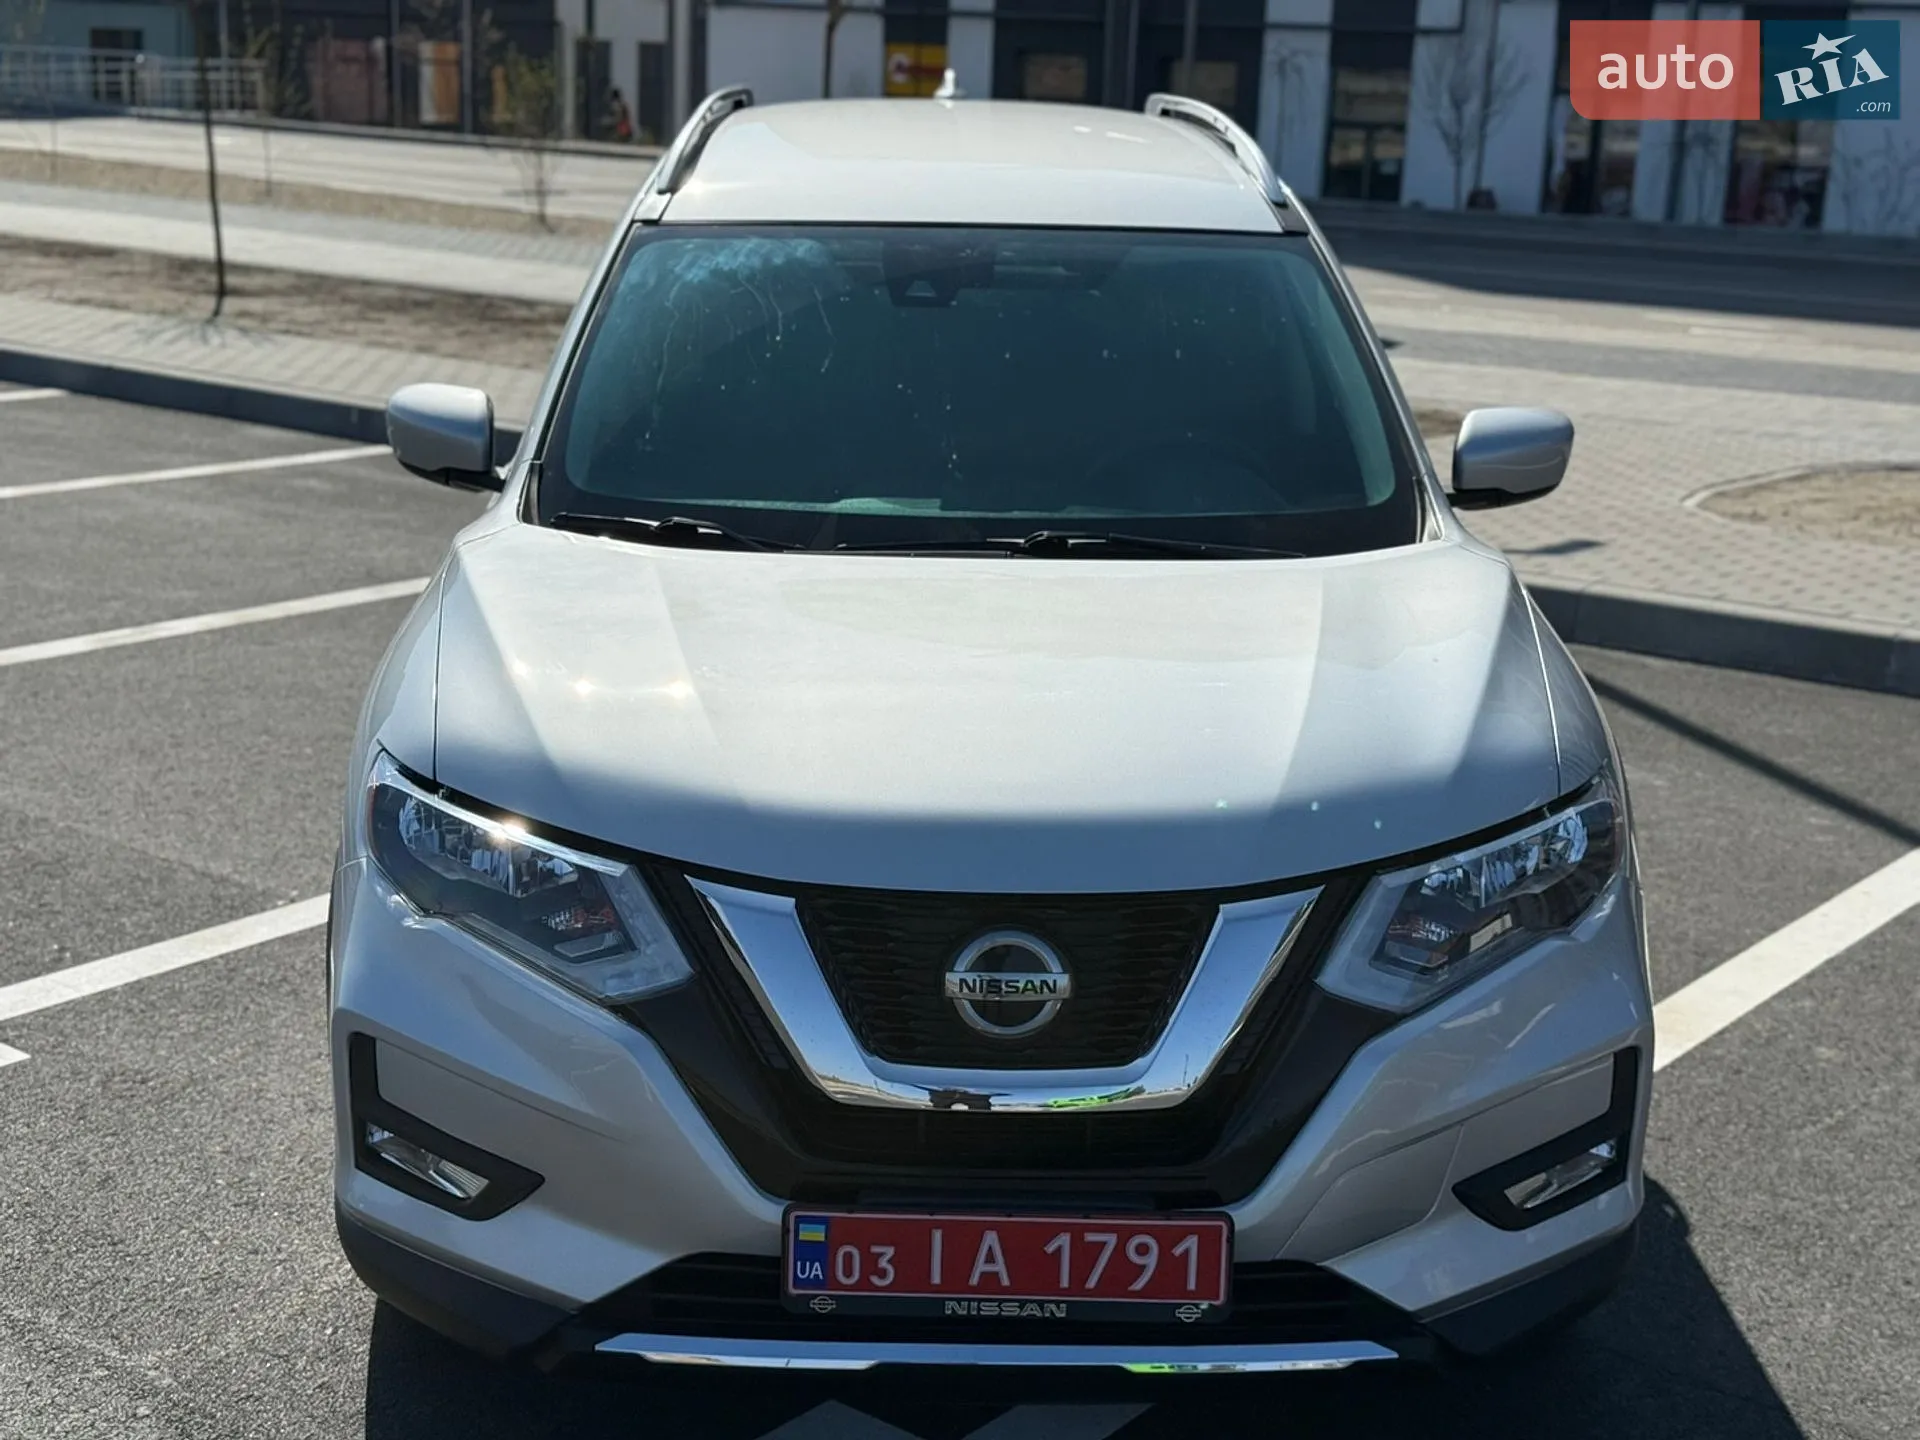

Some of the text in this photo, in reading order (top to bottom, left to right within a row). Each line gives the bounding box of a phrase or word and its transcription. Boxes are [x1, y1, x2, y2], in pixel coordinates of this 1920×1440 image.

[958, 978, 1057, 995] NISSAN
[835, 1245, 896, 1287] 03
[1044, 1231, 1199, 1291] 1791
[797, 1262, 823, 1281] UA
[944, 1300, 1067, 1318] NISSAN
